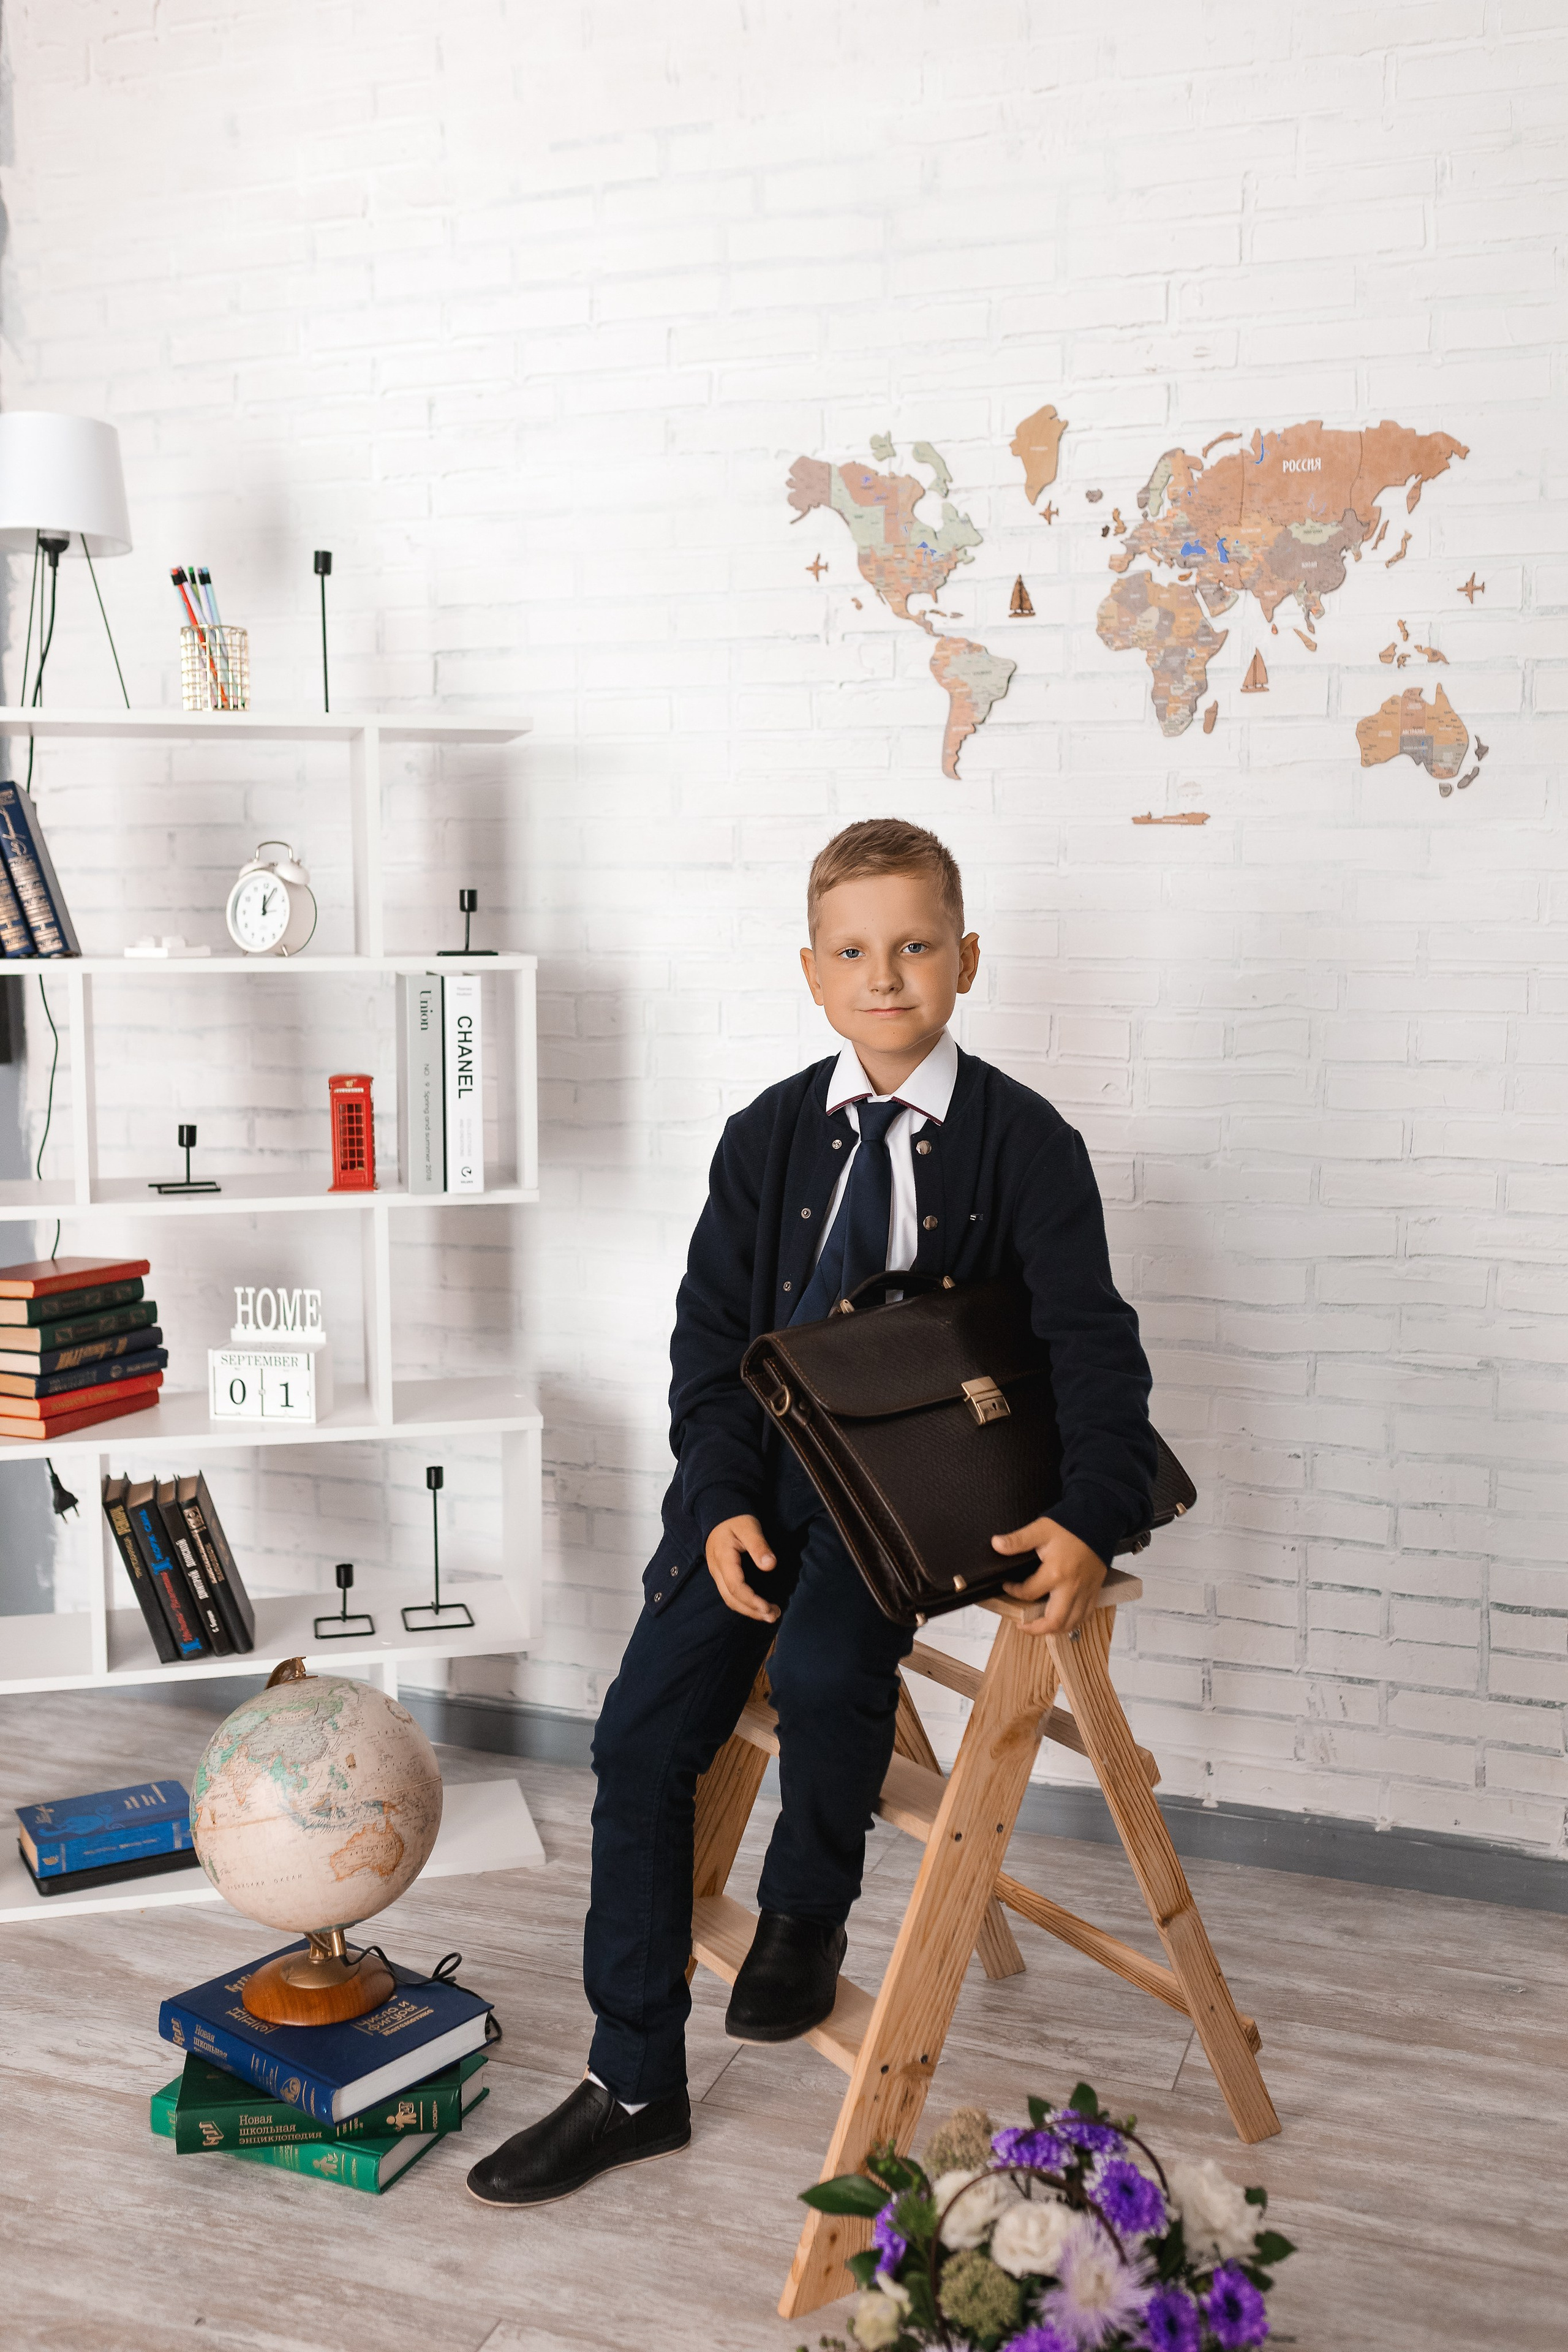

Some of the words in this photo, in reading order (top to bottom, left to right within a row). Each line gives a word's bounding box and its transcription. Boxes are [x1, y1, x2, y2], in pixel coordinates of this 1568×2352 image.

[1283, 457, 1321, 473] РОССИЯ
[420, 990, 432, 1030] Union
[458, 1016, 473, 1099] CHANEL
[234, 1287, 322, 1332] HOME
[221, 1354, 299, 1367] SEPTEMBER
[229, 1378, 246, 1405] 0
[280, 1382, 294, 1408] 1
[274, 1874, 302, 1884] ОКЕАН
[356, 2007, 399, 2026] Числа
[368, 2004, 418, 2031] фигуры
[195, 2024, 215, 2043] Новая
[193, 2037, 228, 2059] школьная
[239, 2115, 273, 2126] Новая
[239, 2124, 296, 2136] школьная
[239, 2132, 322, 2144] энциклопедия
